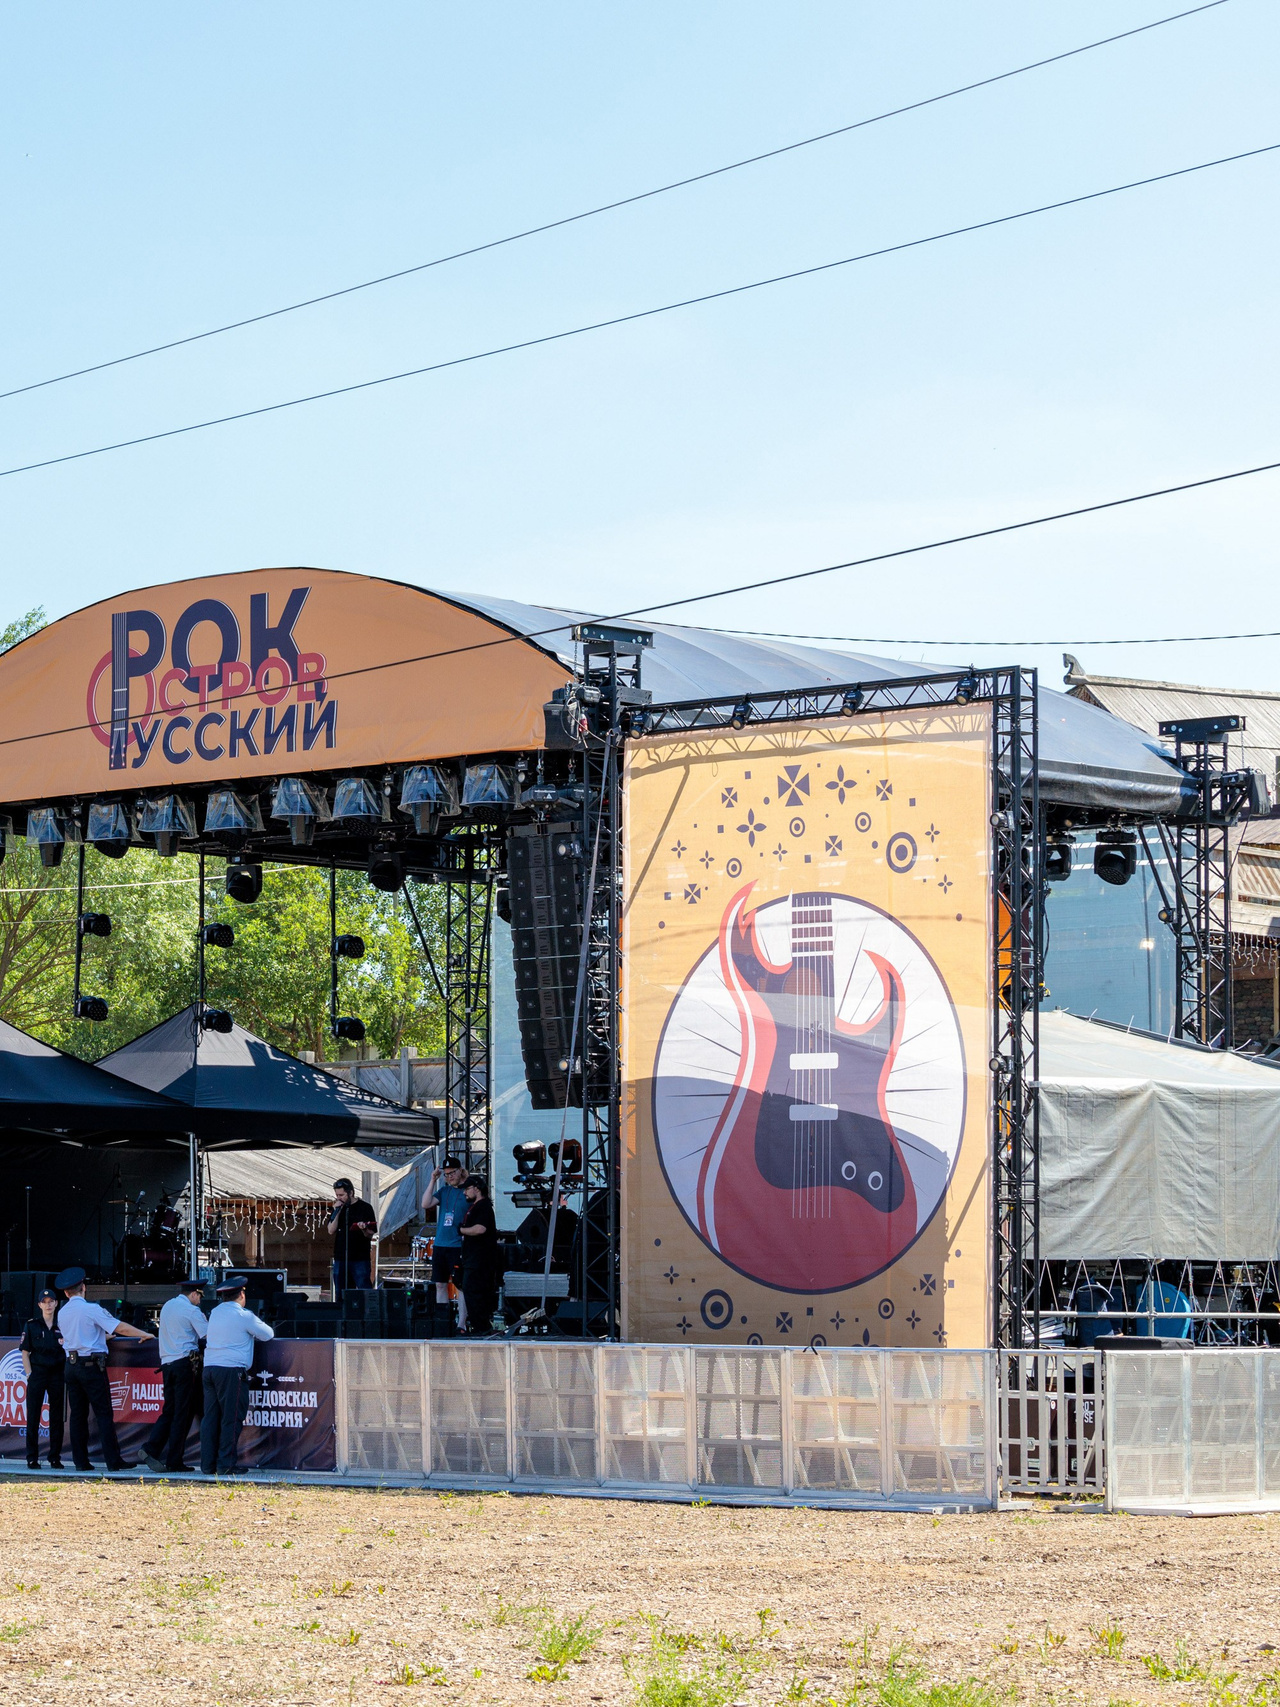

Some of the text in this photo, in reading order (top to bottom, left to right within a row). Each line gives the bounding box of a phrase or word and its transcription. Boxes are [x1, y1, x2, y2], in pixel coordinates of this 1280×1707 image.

[111, 586, 313, 696] РОК
[132, 1383, 164, 1400] НАШЕ
[248, 1390, 317, 1408] ДЕДОВСКАЯ
[132, 1403, 160, 1412] РАДИО
[243, 1410, 303, 1428] ВОВАРНЯ
